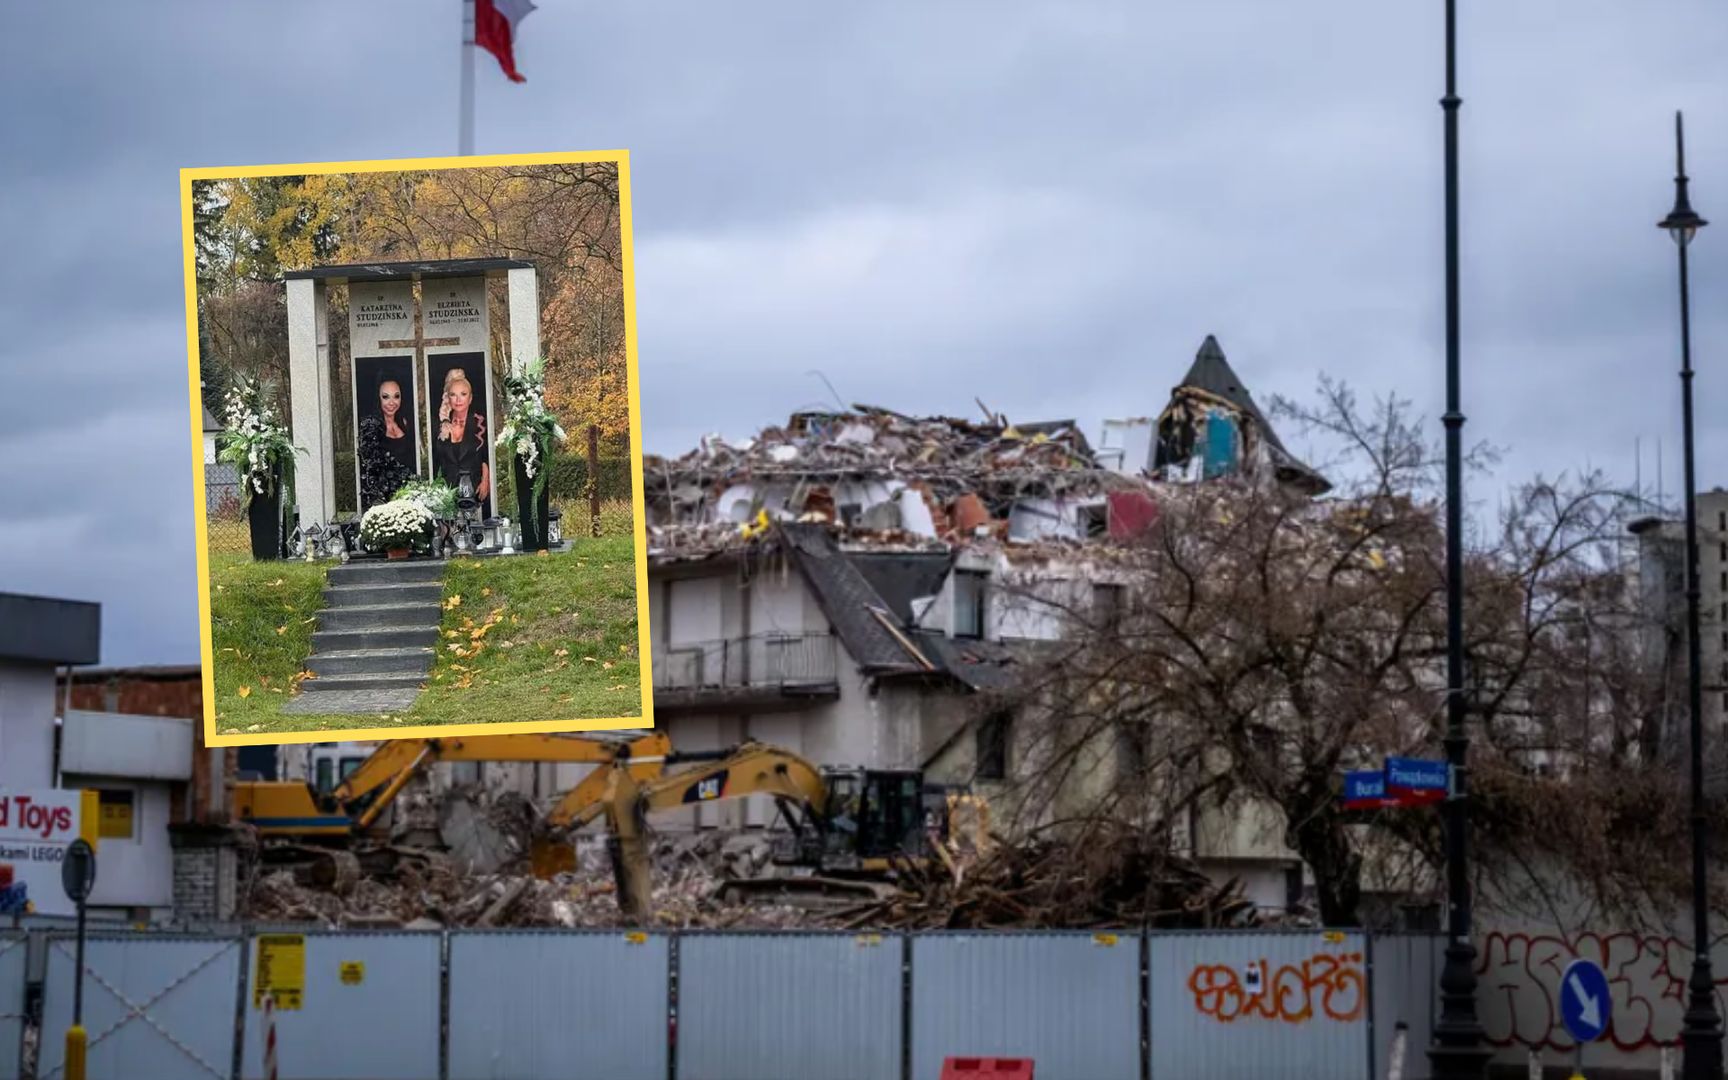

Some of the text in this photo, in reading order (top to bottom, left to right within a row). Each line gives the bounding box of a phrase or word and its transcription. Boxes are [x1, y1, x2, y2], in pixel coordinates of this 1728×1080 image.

[360, 304, 403, 312] KATARZYNA
[14, 796, 72, 838] Toys
[31, 847, 64, 862] LEGO
